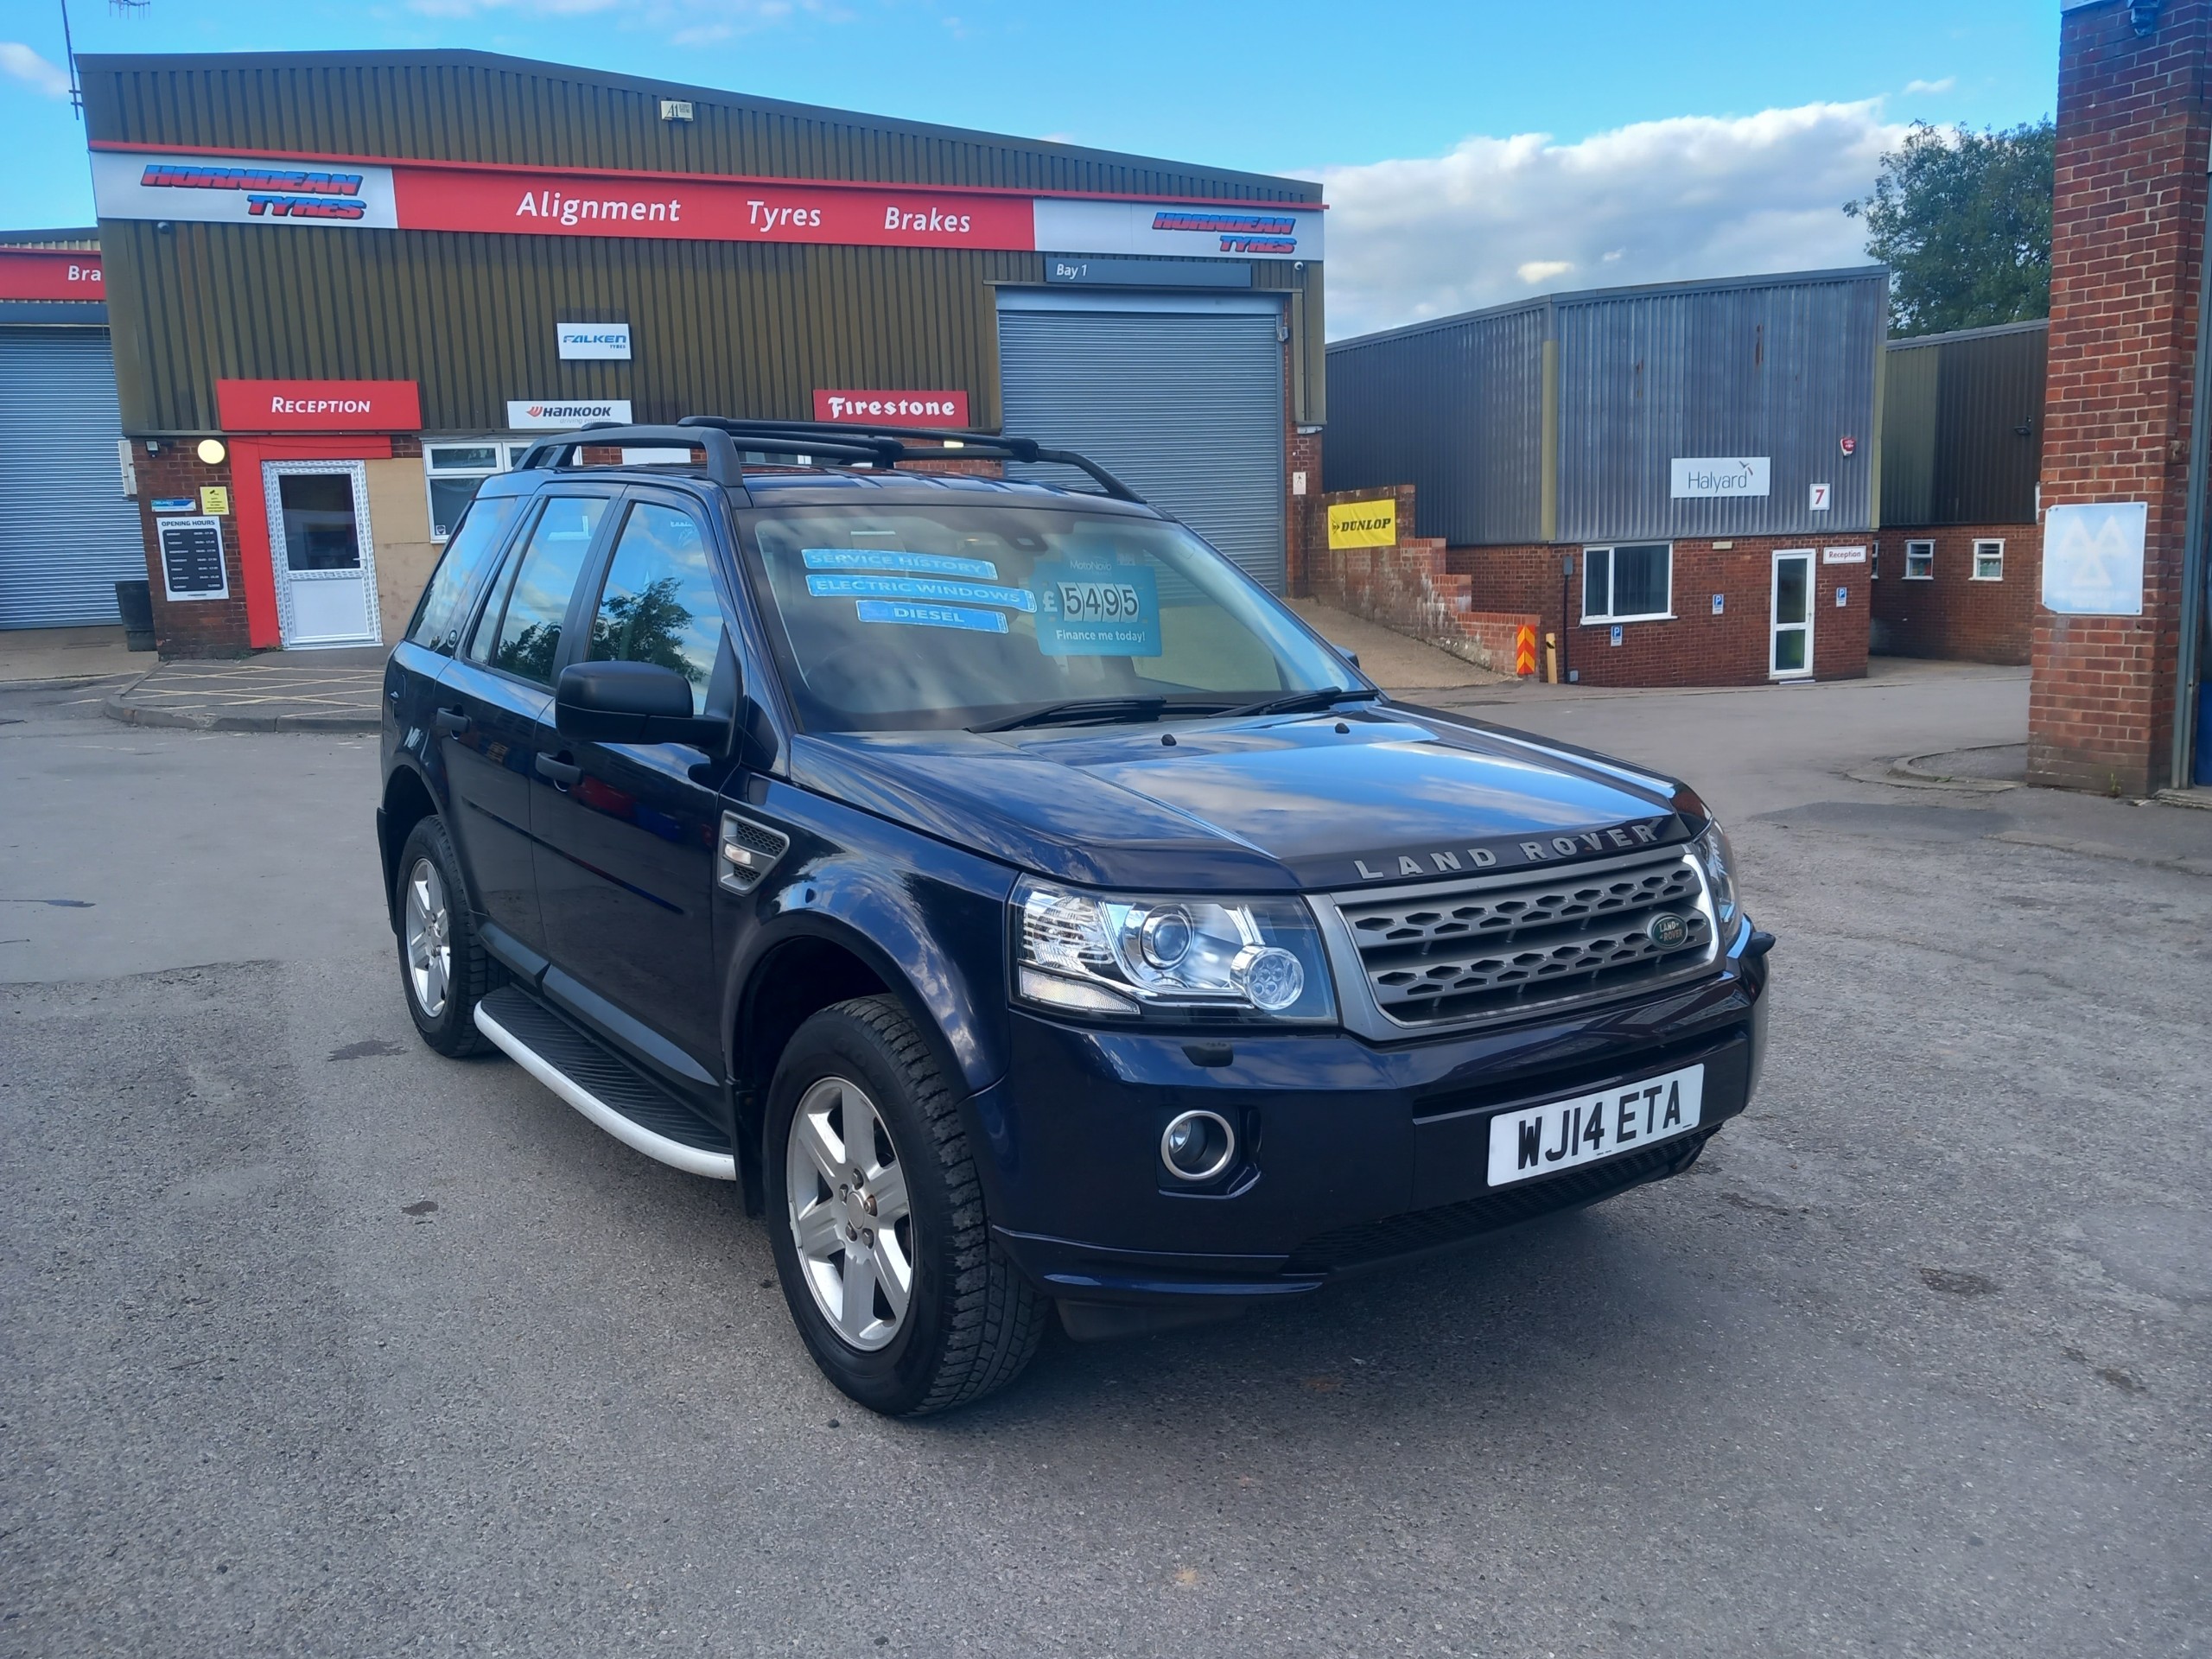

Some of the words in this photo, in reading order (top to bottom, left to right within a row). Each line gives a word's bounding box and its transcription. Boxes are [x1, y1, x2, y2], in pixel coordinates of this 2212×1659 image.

[141, 164, 363, 196] HORNDEAN
[247, 194, 366, 219] TYRES
[516, 191, 681, 226] Alignment
[747, 200, 821, 232] Tyres
[884, 207, 971, 232] Brakes
[1152, 212, 1296, 234] HORNDEAN
[1219, 235, 1296, 254] TYRES
[1056, 264, 1078, 279] Bay
[1080, 264, 1087, 276] 1
[563, 334, 626, 343] FALKEN
[828, 397, 955, 419] Firestone
[1688, 471, 1747, 493] Halyard
[1815, 489, 1825, 505] 7
[1341, 518, 1391, 532] DUNLOP
[1828, 550, 1861, 559] Reception
[811, 555, 893, 565] SERVICE
[899, 556, 982, 574] HISTORY
[817, 580, 911, 592] ELECTRIC
[916, 583, 1020, 602] WINDOWS
[893, 607, 965, 623] DIESEL
[1056, 630, 1096, 640] Finance
[1116, 631, 1146, 643] today!
[1354, 848, 1497, 880] LAND
[1519, 823, 1658, 861] ROVER
[1659, 921, 1676, 932] LAND
[1663, 929, 1683, 941] ROVER
[1518, 1102, 1605, 1170] WJ14
[1617, 1080, 1681, 1144] ETA
